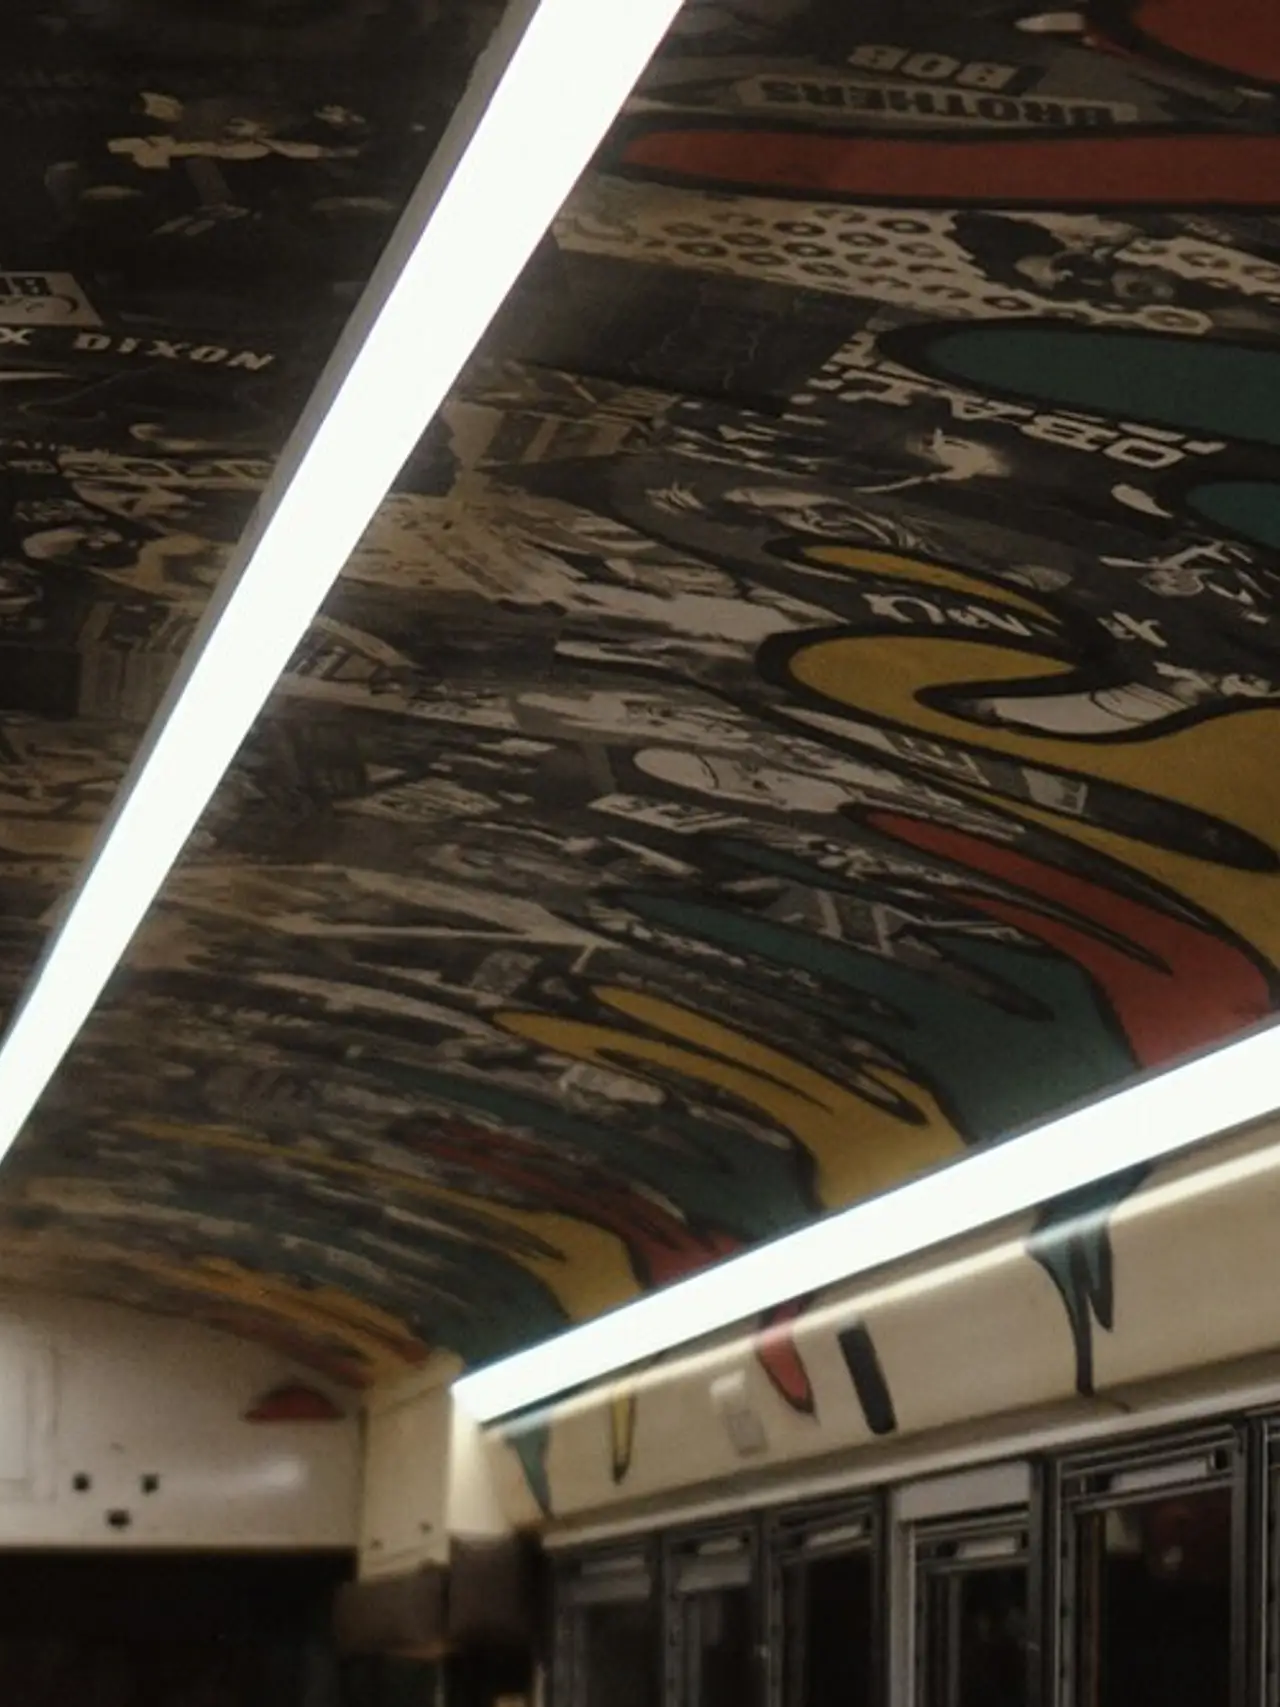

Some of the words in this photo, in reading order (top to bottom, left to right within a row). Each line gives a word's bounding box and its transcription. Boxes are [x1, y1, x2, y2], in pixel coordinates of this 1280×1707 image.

[846, 44, 1020, 91] BOB
[760, 79, 1118, 125] BROTHERS
[74, 332, 276, 371] DIXON
